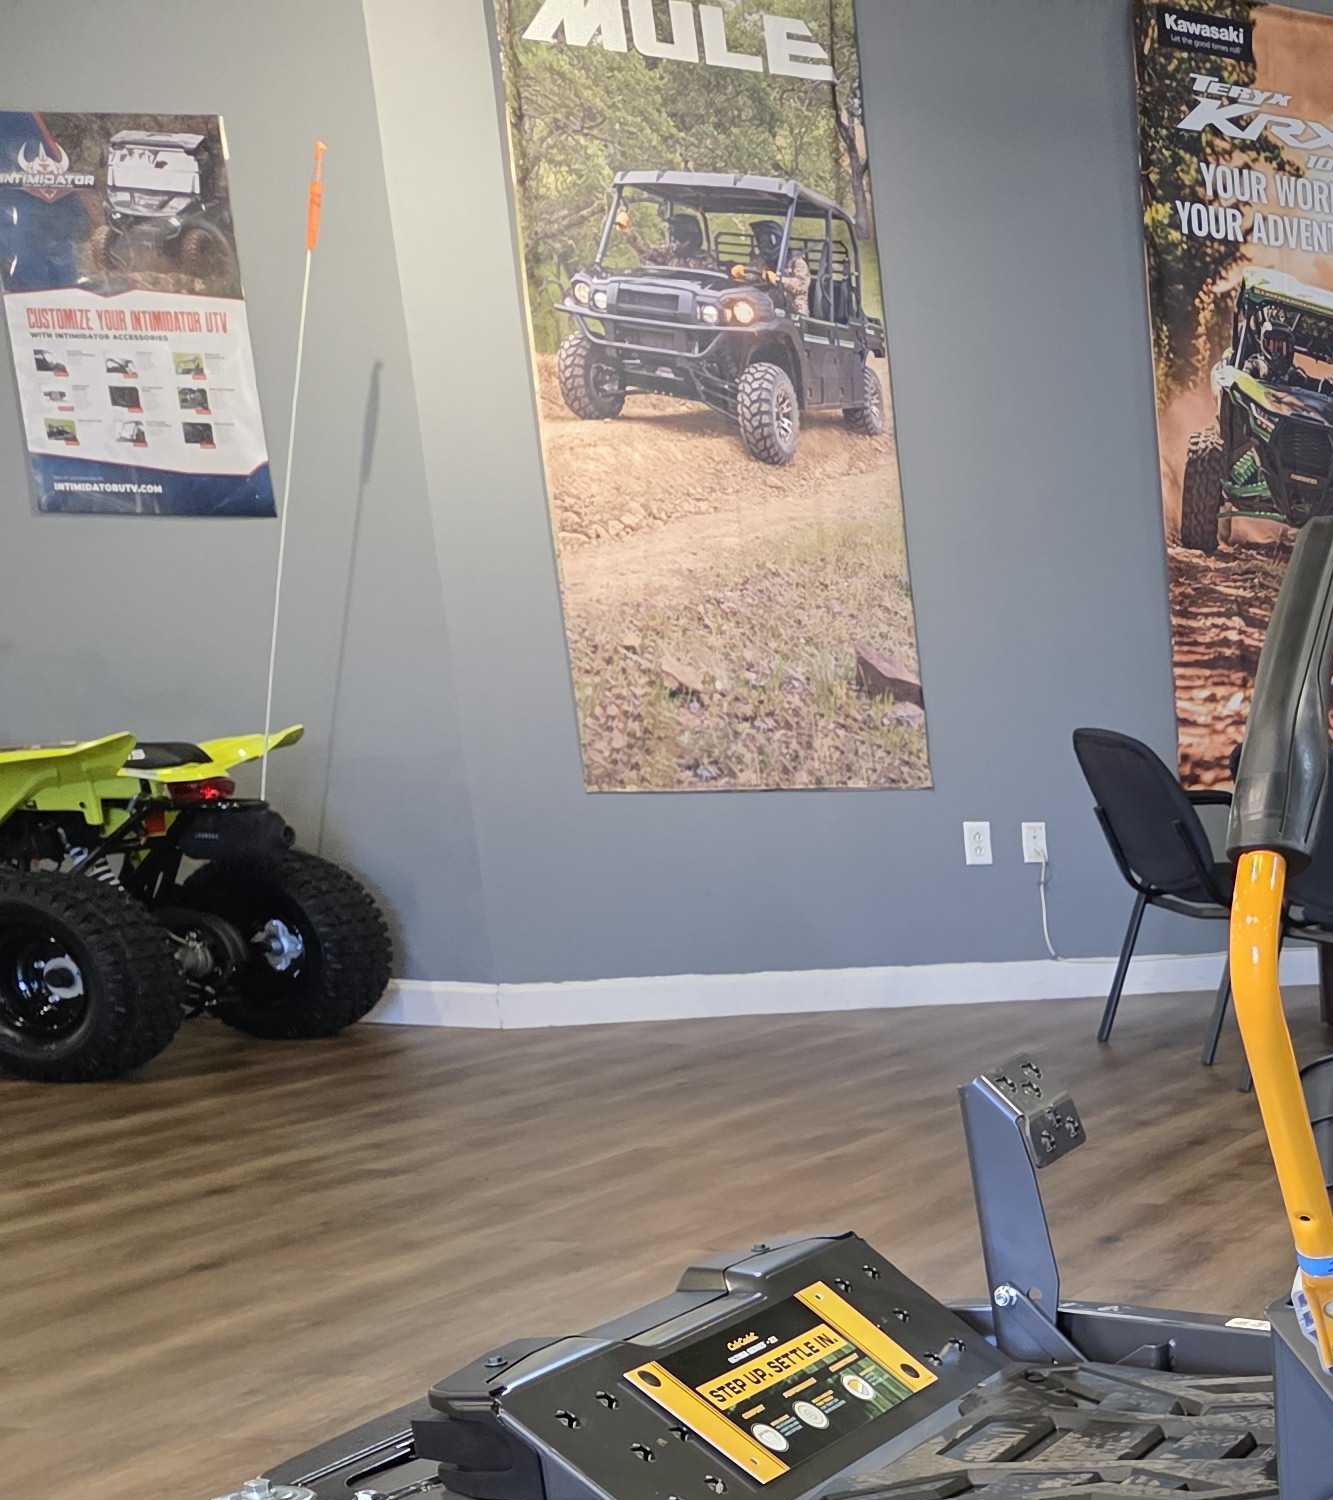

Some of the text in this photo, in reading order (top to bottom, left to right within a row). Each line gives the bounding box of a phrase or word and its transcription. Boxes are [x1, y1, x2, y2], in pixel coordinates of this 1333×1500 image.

[522, 0, 836, 82] MULE
[1164, 12, 1244, 44] Kawasaki
[1189, 73, 1292, 107] TERYX
[1200, 162, 1268, 204] YOUR
[1175, 200, 1244, 242] YOUR
[26, 308, 229, 334] CUSTOMIZE YOUR INTIMIDATOR UTV
[709, 1378, 748, 1403] STEP
[767, 1341, 820, 1373] SETTLE
[813, 1333, 839, 1349] IN.
